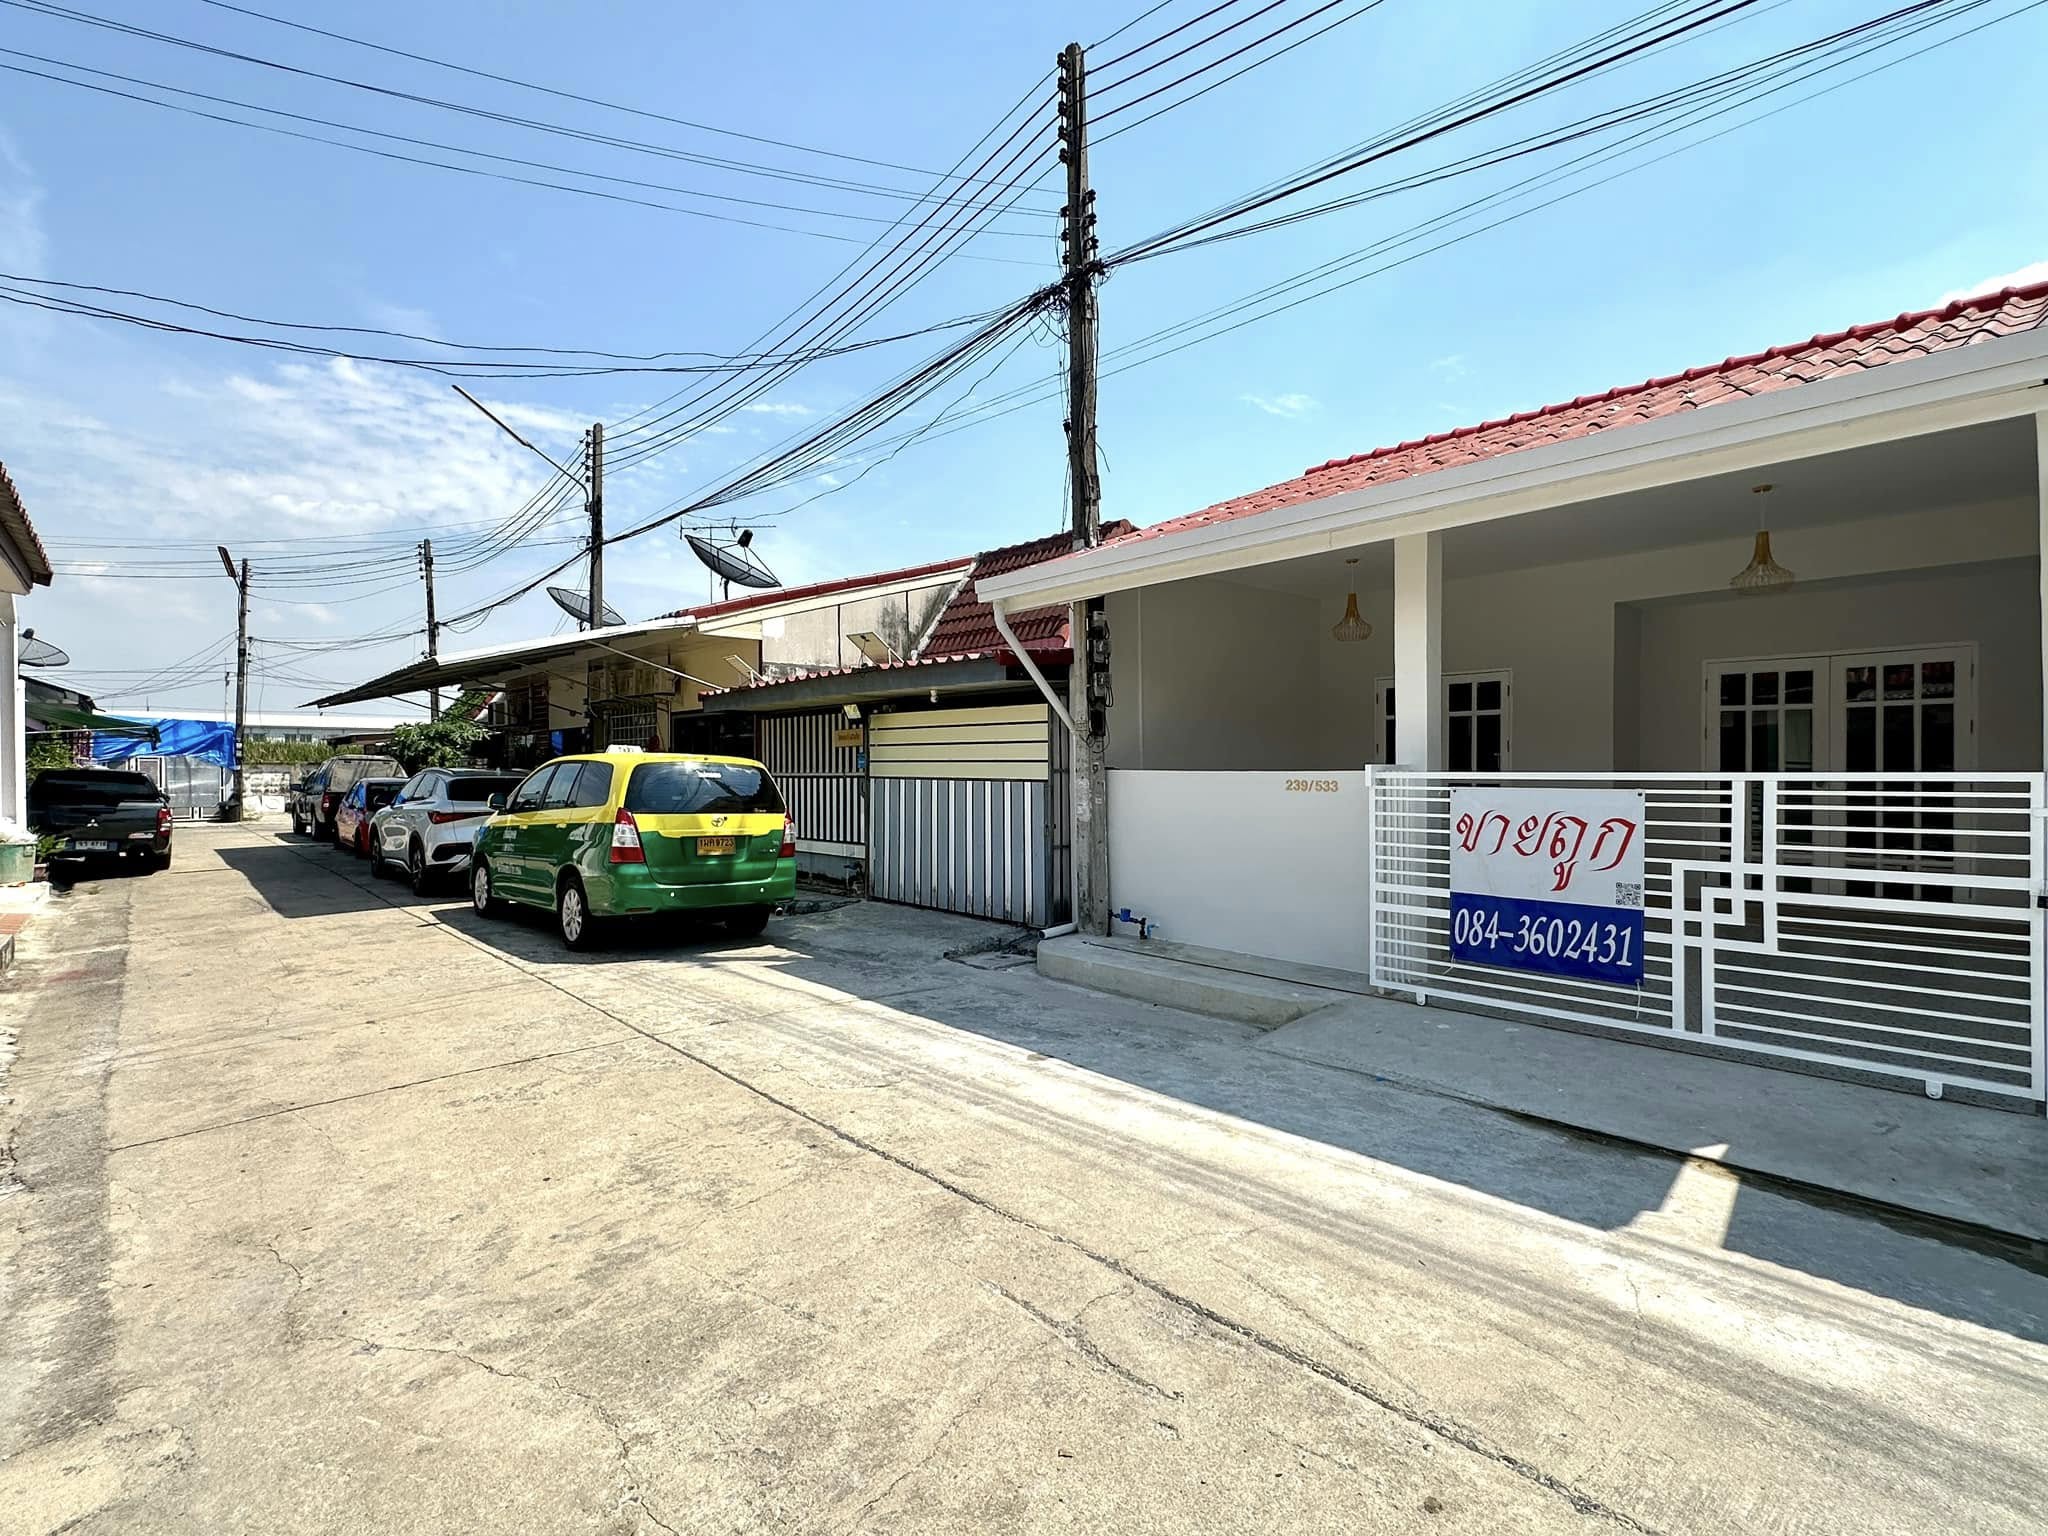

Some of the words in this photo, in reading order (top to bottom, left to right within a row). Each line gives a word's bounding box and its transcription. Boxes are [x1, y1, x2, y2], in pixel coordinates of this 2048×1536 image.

[1286, 779, 1338, 792] 239/533
[1456, 810, 1637, 892] ขายถูก
[1454, 908, 1632, 967] 084-3602431
